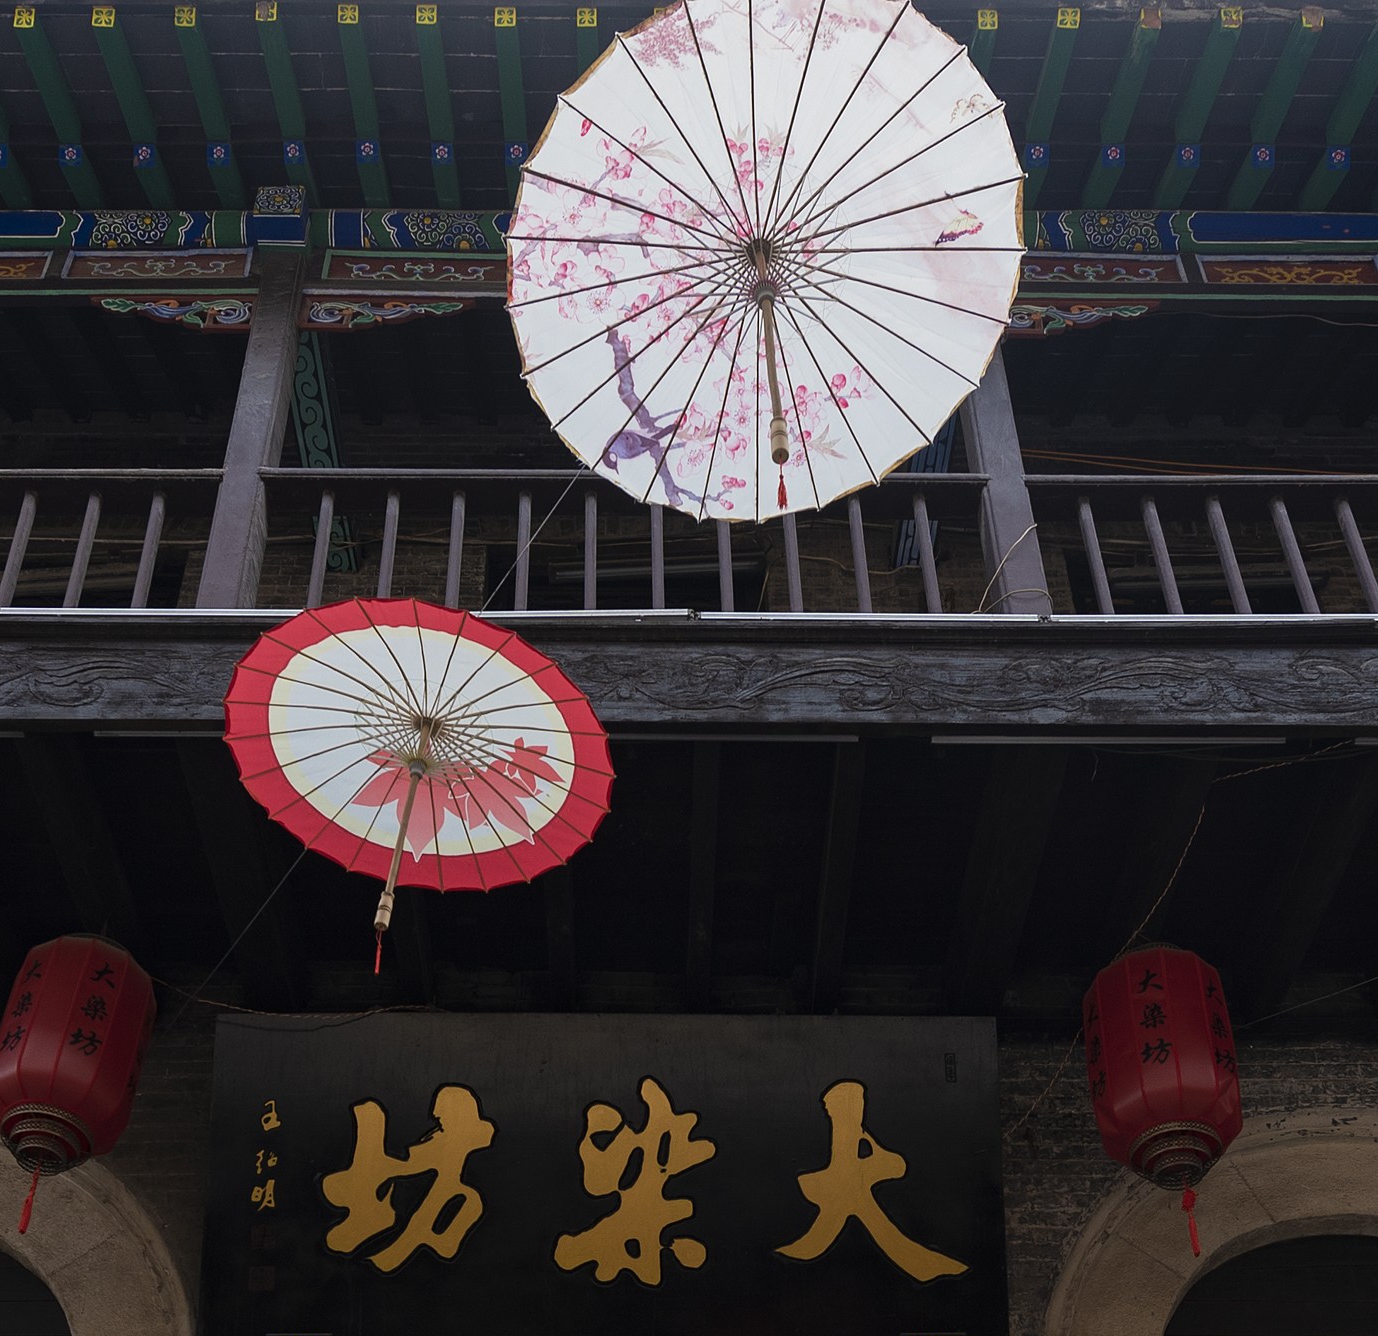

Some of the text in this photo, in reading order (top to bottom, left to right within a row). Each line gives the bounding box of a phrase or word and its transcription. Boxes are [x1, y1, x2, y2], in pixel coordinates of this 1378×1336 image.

[0, 960, 43, 1052] 大染坊
[69, 962, 115, 1056] 大染坊
[1138, 970, 1172, 1065] 大染坊
[1204, 979, 1237, 1075] 大染坊
[324, 1076, 969, 1284] 大染坊
